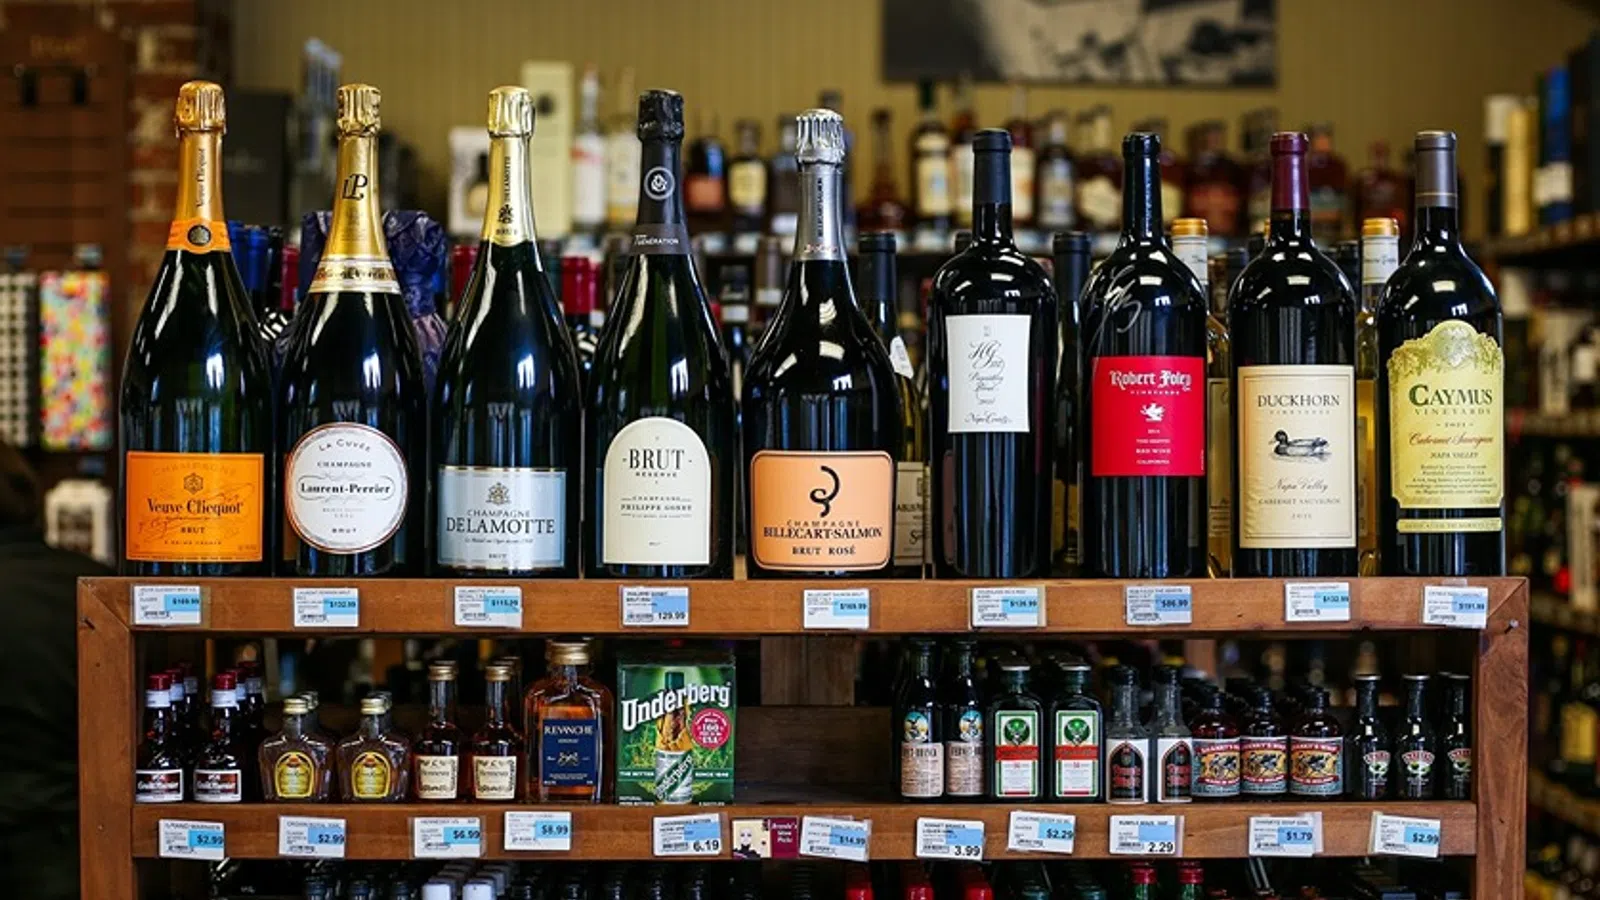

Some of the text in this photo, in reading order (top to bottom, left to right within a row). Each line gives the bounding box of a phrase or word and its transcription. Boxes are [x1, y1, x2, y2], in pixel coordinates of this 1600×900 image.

[1109, 369, 1192, 392] Robert Foley
[1257, 394, 1341, 408] DUCKHORN
[1408, 383, 1493, 407] CAYMUS
[1414, 408, 1491, 416] VINEYARDS
[317, 461, 372, 469] CHAMPAGNE
[629, 448, 685, 470] BRUT
[301, 482, 391, 494] Laurent-Perrier
[1270, 477, 1329, 492] Napa Valley
[147, 497, 243, 517] Veuve Clicquot
[467, 509, 531, 518] CHAMPAGNE
[180, 526, 206, 534] BRUT
[446, 517, 556, 535] DELAMOTTE
[791, 545, 856, 555] BRUT ROSÉ
[620, 681, 732, 732] Underberg
[544, 725, 593, 735] REVANCHE
[197, 834, 224, 845] $2.99
[318, 833, 345, 844] $2.99
[1046, 828, 1075, 840] $2.29
[1286, 830, 1313, 841] $1.79
[1412, 832, 1440, 845] $2.99
[693, 838, 720, 852] 6.19
[954, 845, 980, 857] 3.99
[1148, 841, 1174, 853] 2.29
